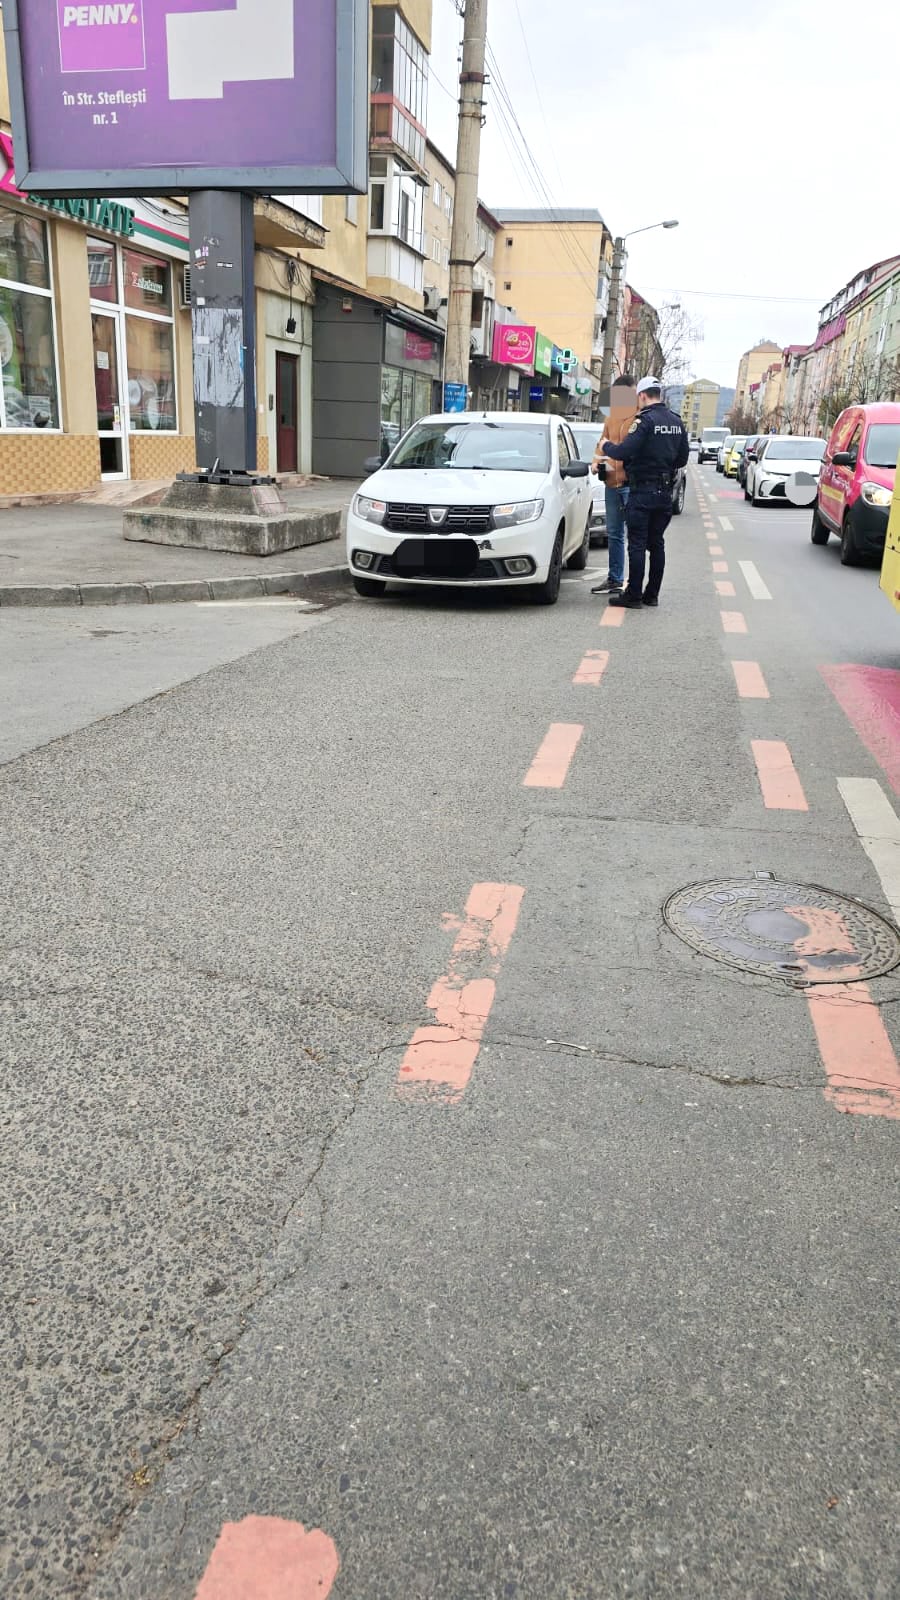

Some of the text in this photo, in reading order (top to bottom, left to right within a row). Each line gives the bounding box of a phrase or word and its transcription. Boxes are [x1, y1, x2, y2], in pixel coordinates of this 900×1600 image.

[62, 90, 75, 106] în
[77, 92, 96, 105] Str.
[93, 111, 118, 125] nr. 1
